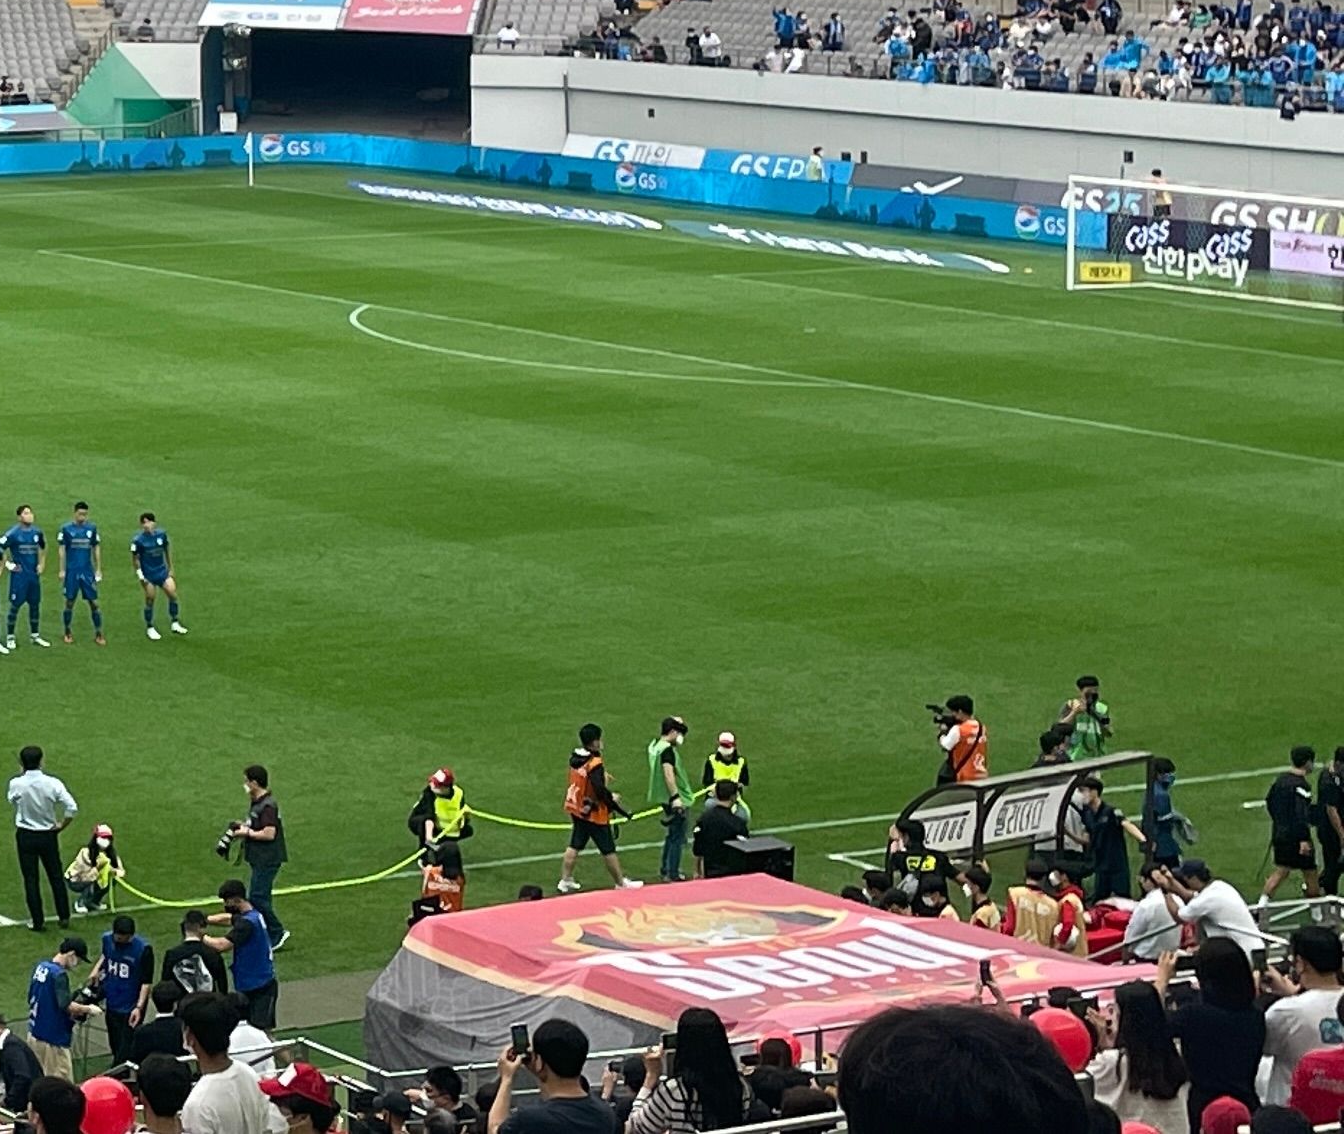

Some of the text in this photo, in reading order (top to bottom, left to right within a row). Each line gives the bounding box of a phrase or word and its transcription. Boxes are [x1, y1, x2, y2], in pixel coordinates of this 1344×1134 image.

[594, 139, 630, 162] GS
[730, 153, 770, 178] GS
[1211, 201, 1260, 228] GS
